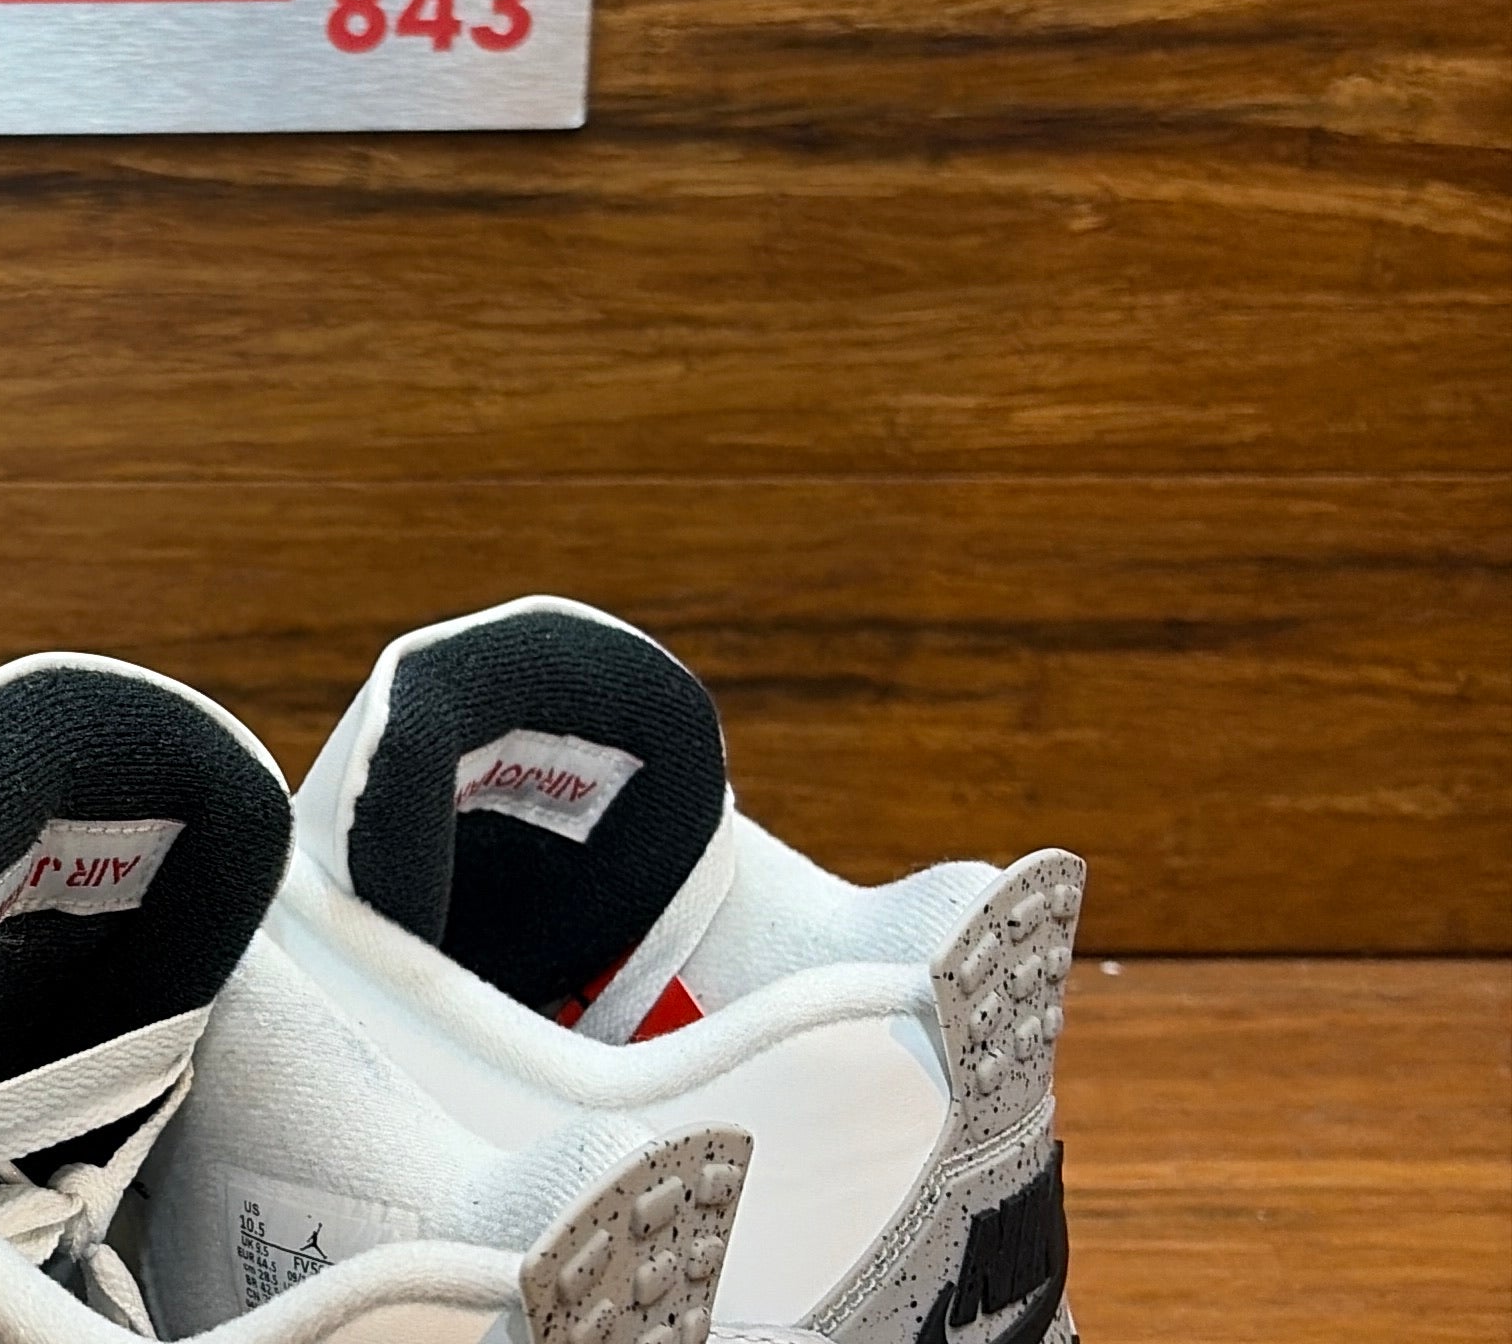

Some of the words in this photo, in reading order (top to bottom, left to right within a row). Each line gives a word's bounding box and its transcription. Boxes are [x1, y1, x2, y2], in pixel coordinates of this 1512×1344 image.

[65, 854, 142, 888] AIR
[243, 1199, 261, 1217] US
[239, 1214, 266, 1238] 10.5
[237, 1245, 255, 1263] EUR
[241, 1235, 254, 1250] UK
[255, 1241, 270, 1258] 9.5
